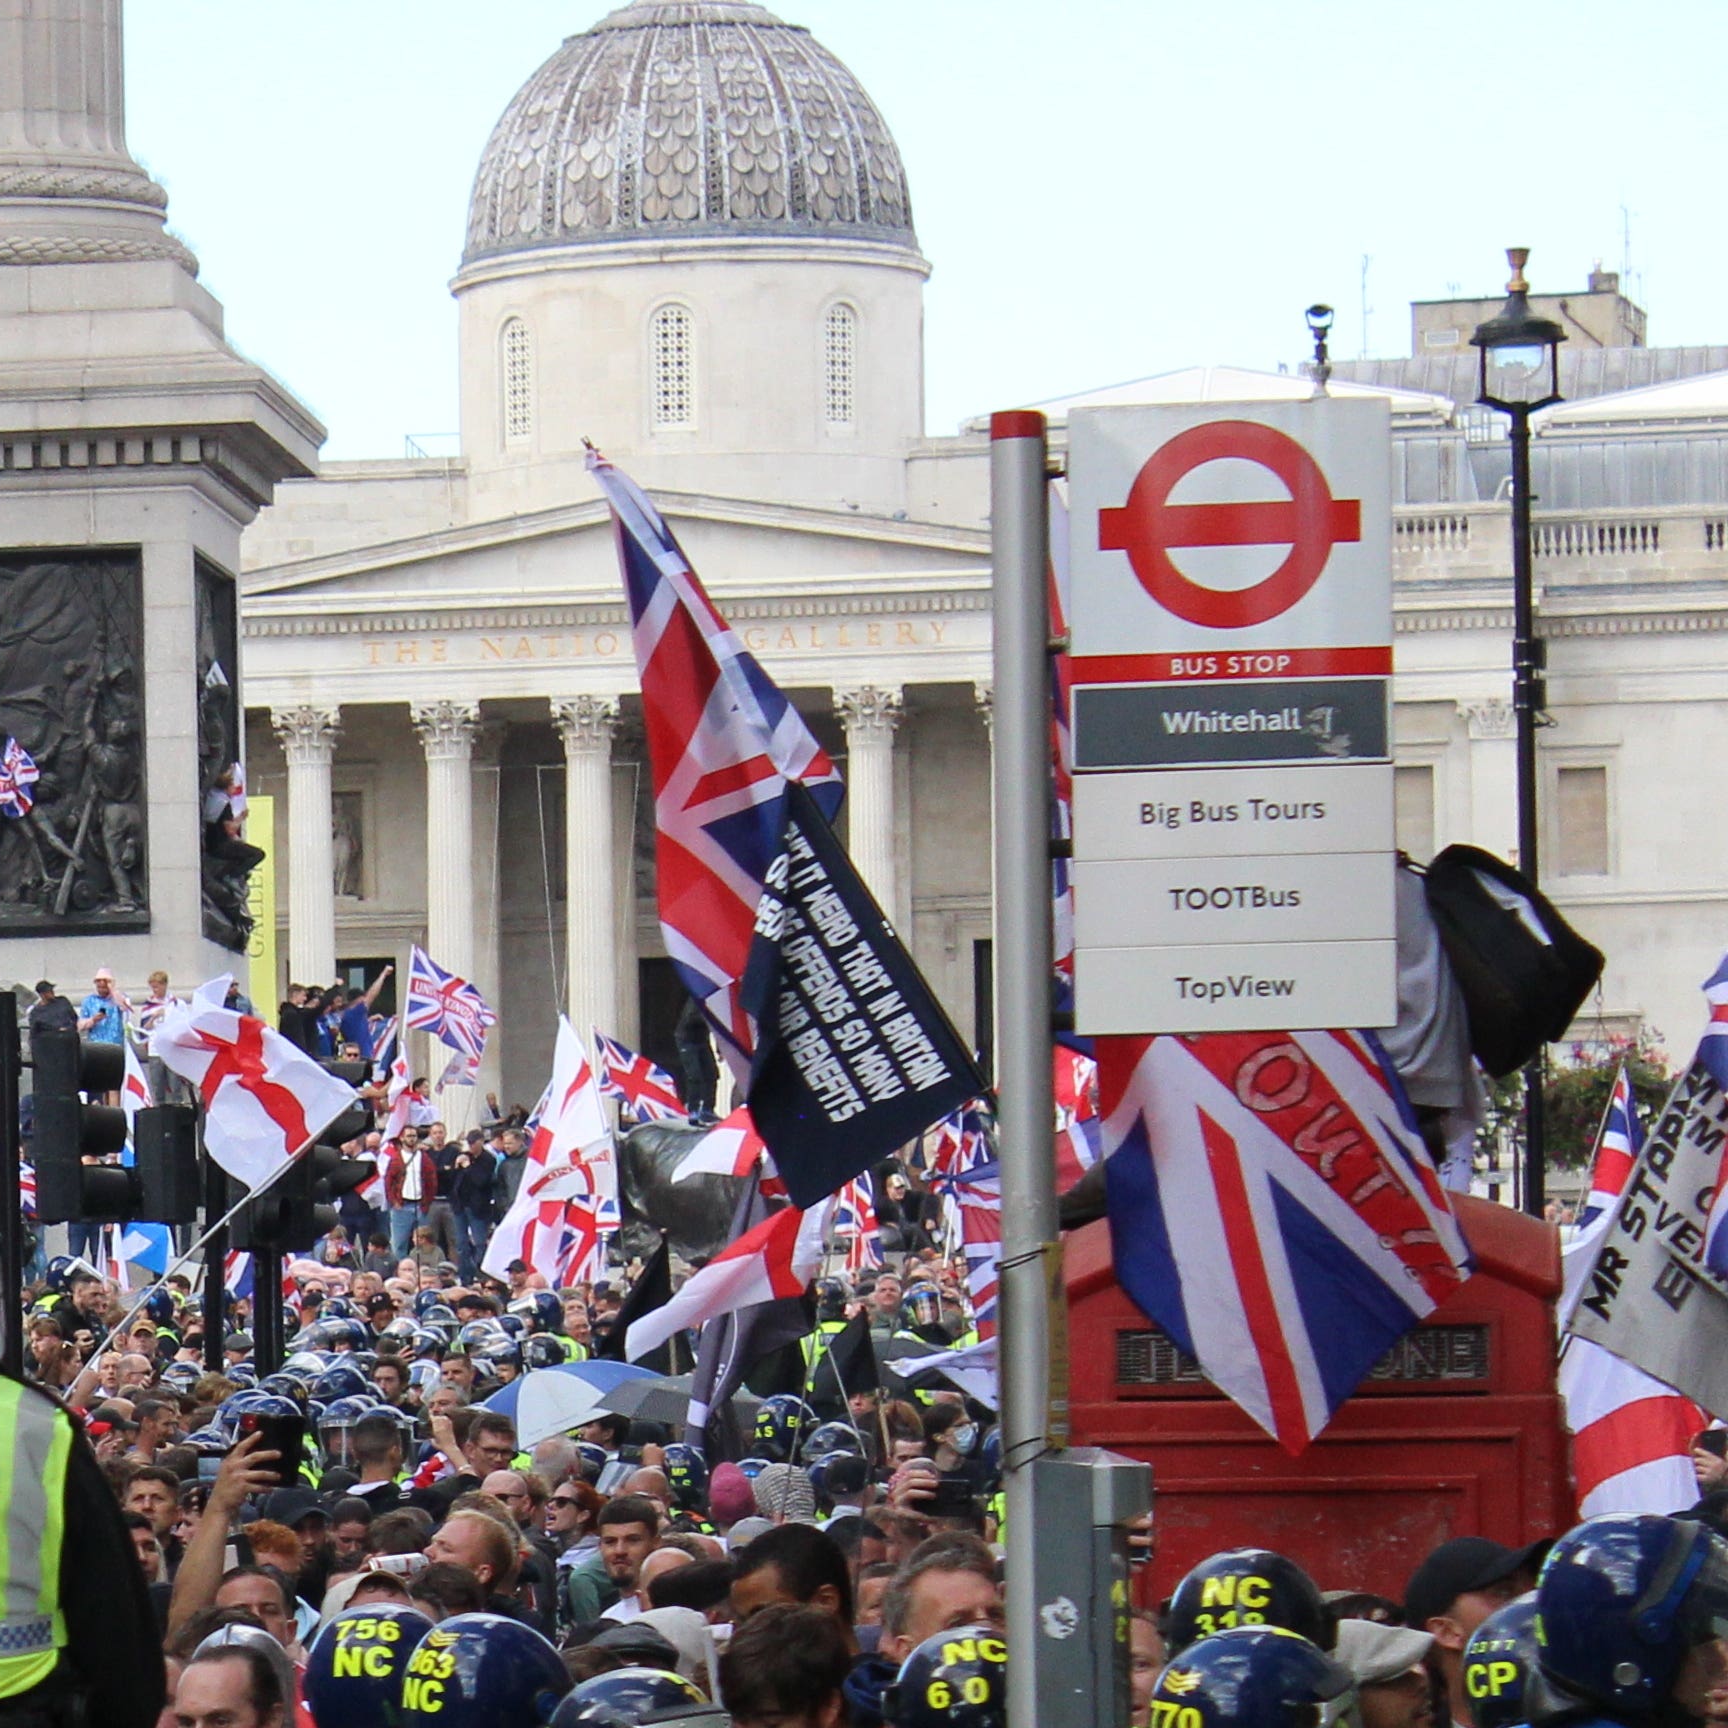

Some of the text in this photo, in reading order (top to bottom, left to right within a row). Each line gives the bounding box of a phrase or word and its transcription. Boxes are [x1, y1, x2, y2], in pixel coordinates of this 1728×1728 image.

[363, 621, 949, 664] THE NATIO GALLERY
[1170, 655, 1290, 676] BUS STOP
[1161, 708, 1301, 735] Whitehall
[1140, 798, 1326, 829] Big Bus Tours
[1168, 886, 1301, 911] TOOTBus
[803, 884, 860, 947] WEIRD
[790, 934, 857, 1024] OFFENDS
[839, 940, 892, 997] THAT
[1175, 976, 1295, 1003] TopView
[867, 991, 907, 1022] IN
[832, 1018, 873, 1051] SO
[881, 1011, 951, 1092] BRITAIN
[789, 1028, 867, 1123] BENEFITS
[850, 1044, 905, 1102] MANY
[1583, 1244, 1630, 1322] MR
[1201, 1575, 1272, 1608] NC
[335, 1618, 401, 1642] 756
[332, 1645, 394, 1677] NC
[943, 1638, 1007, 1666] NC
[402, 1677, 445, 1713] NC
[1466, 1661, 1518, 1698] CP
